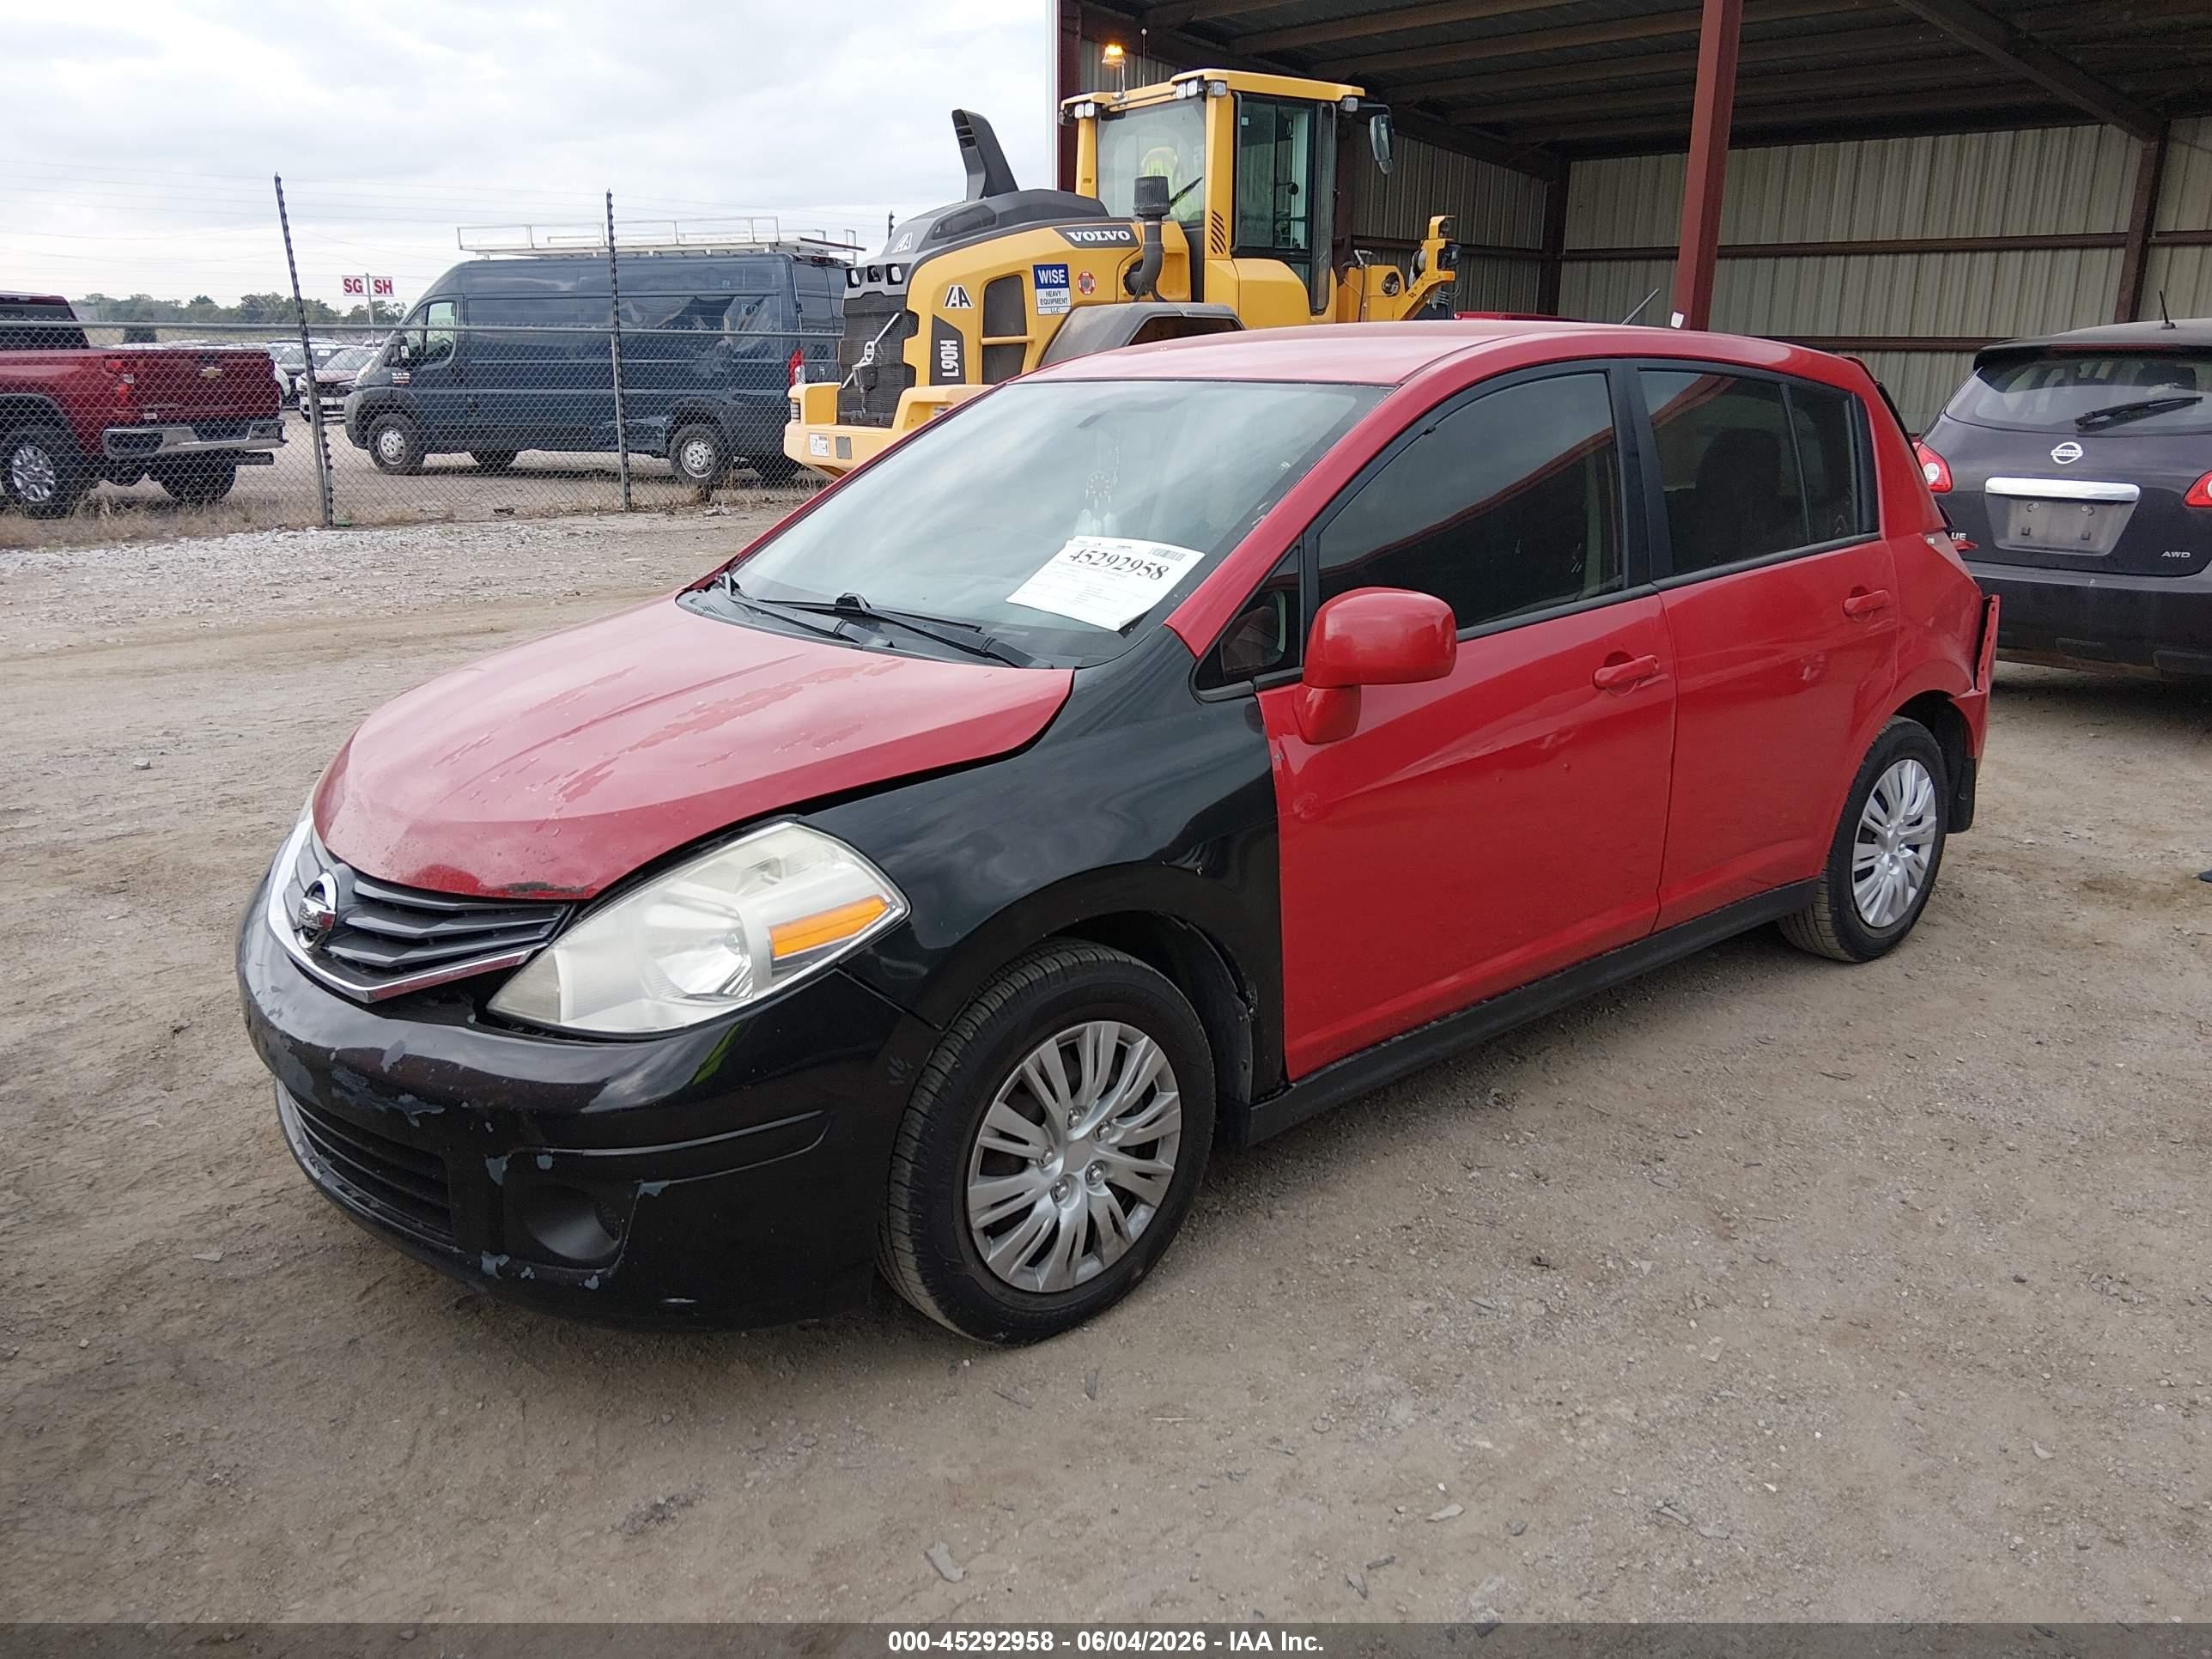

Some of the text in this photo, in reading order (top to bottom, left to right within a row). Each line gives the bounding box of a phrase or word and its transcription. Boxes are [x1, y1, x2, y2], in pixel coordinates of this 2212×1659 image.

[1066, 230, 1131, 241] VOLVO
[1037, 269, 1066, 285] WISE
[343, 278, 363, 293] SG
[374, 279, 393, 294] SH
[1039, 297, 1068, 306] EQUIPMENT
[939, 339, 960, 378] L90H
[1069, 548, 1170, 580] 45292958
